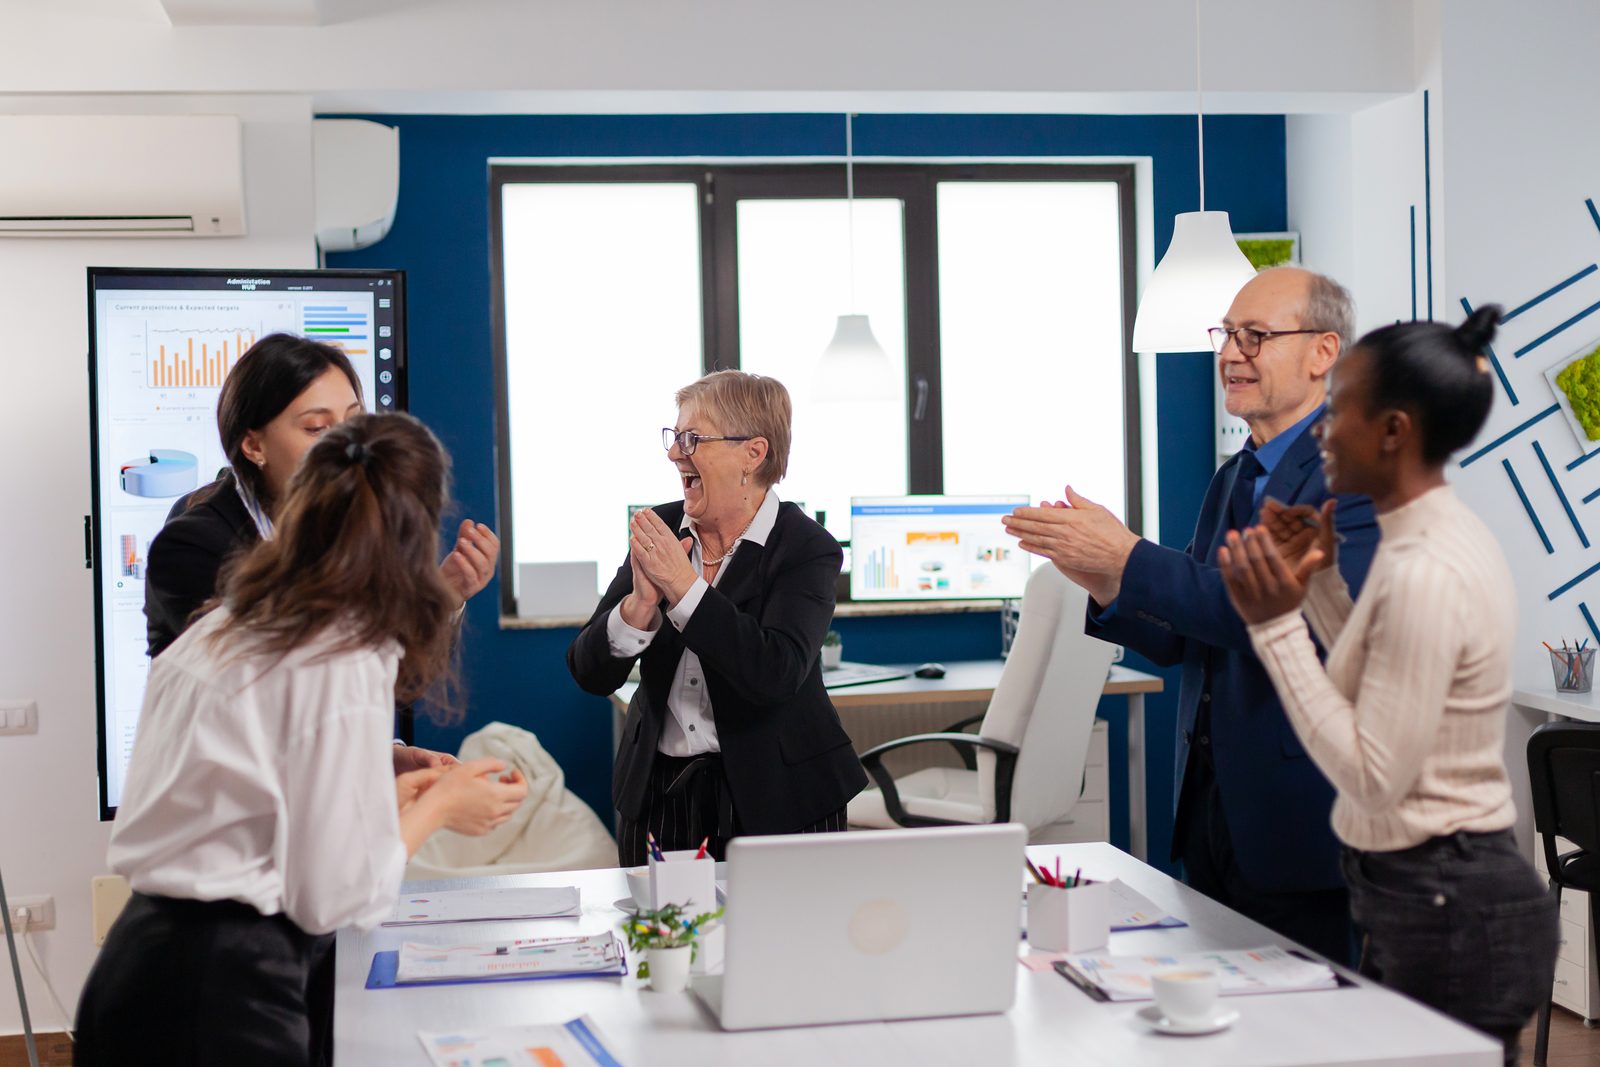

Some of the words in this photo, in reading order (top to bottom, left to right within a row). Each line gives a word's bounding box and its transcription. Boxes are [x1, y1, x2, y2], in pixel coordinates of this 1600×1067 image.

[114, 303, 140, 311] Current
[141, 304, 178, 312] projections
[186, 304, 215, 312] Expected
[216, 304, 240, 312] targets
